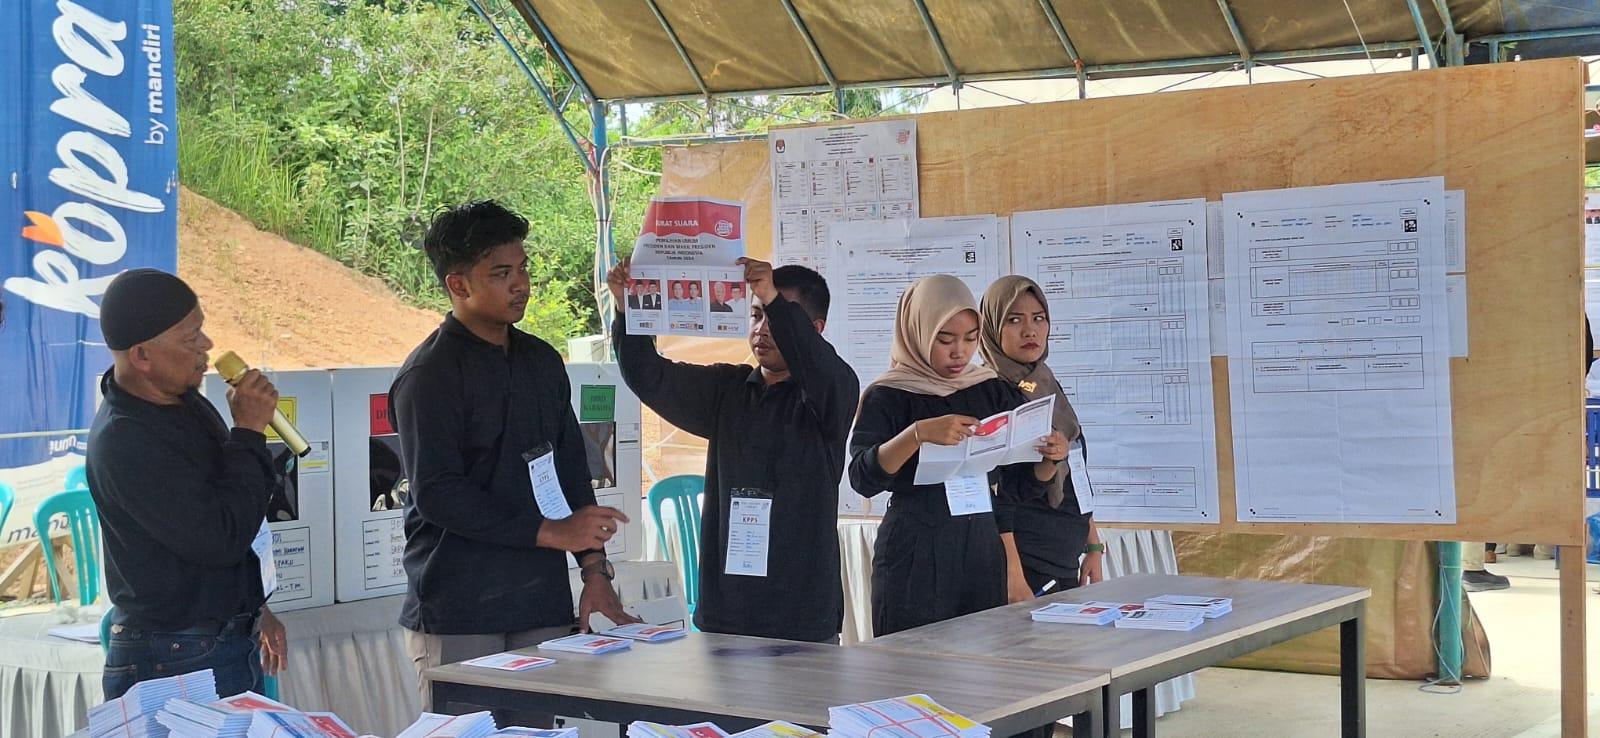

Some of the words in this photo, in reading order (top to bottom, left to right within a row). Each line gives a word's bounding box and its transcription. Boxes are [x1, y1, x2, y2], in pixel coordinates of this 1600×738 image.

[142, 24, 163, 113] mandiri
[4, 0, 131, 319] kopra
[144, 117, 169, 144] by
[674, 219, 699, 227] SUARA
